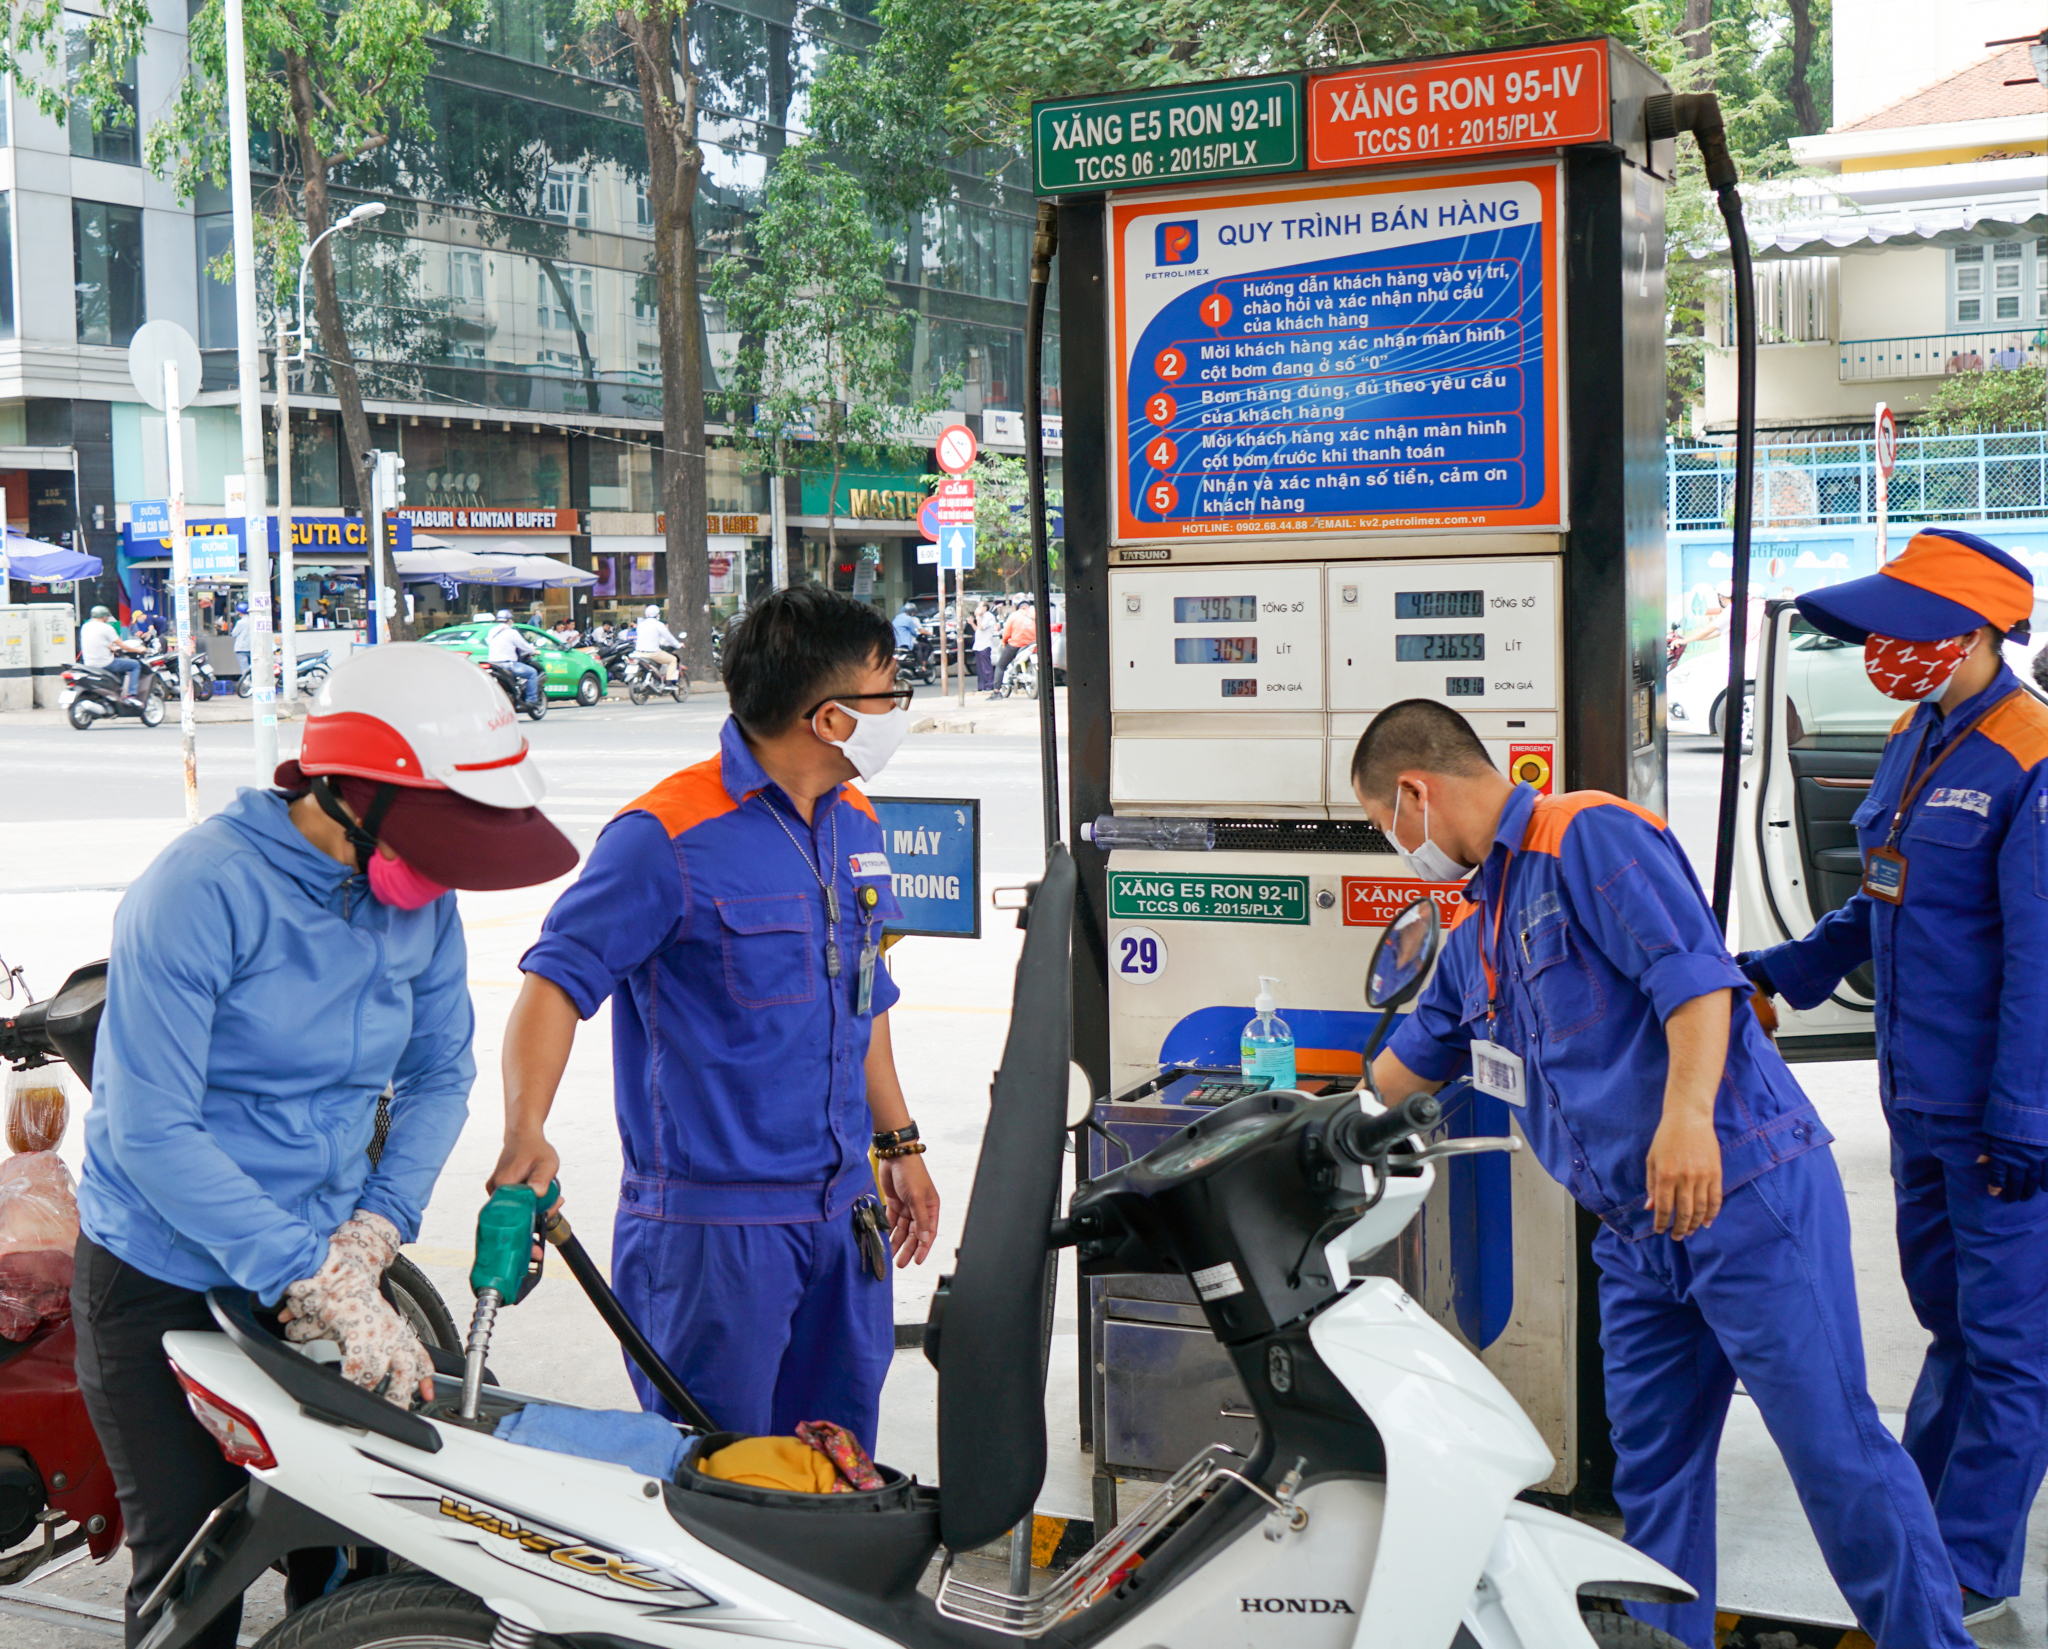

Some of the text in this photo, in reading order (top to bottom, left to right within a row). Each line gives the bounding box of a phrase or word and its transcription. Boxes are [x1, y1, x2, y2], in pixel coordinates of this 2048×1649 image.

[1330, 64, 1583, 122] XĂNG RON 95-IV
[1051, 96, 1282, 151] XĂNG E5 RON 92-II
[1354, 126, 1411, 155] TCCS
[1417, 123, 1439, 149] 01
[1460, 110, 1558, 145] 2015/PLX
[1075, 154, 1127, 181] TCCS
[1132, 152, 1153, 176] 06
[1170, 140, 1257, 172] 2015/PLX
[1218, 199, 1519, 246] QUY TRÌNH BÁN HÀNG
[1145, 268, 1210, 280] PETROLIMEX
[1243, 263, 1510, 298] Hướng dẫn khách hàng vào vị trí,
[1243, 298, 1282, 316] chào
[1286, 295, 1310, 311] hỏi
[1315, 294, 1333, 310] và
[1339, 293, 1367, 309] xác
[1371, 289, 1412, 307] nhận
[1452, 282, 1483, 300] cầu
[1208, 300, 1220, 322] 1
[1243, 313, 1369, 333] của khách hàng
[1201, 326, 1506, 360] Mời khách hàng xác nhận màn hình
[1162, 353, 1178, 376] 2
[1200, 364, 1227, 382] cột
[1231, 362, 1267, 379] bơm
[1272, 361, 1314, 377] đang
[1318, 357, 1330, 373] ở
[1335, 354, 1356, 371] số
[1201, 371, 1507, 404] Bơm hàng đúng, đủ theo yêu cầu
[1153, 398, 1168, 421] 3
[1201, 404, 1345, 425] của khách hàng
[1202, 420, 1507, 449] Mời khách hàng xác nhận màn hình
[1153, 442, 1169, 465] 4
[1202, 443, 1445, 471] cột bơm trước khi thanh toán
[945, 482, 968, 495] CẤM
[1203, 466, 1508, 495] Nhận và xác nhận số tiền, cảm ơn
[1154, 487, 1170, 509] 5
[1203, 497, 1305, 513] khách hàng
[397, 510, 557, 528] SHABURI & KINTAN BUFFET
[1182, 523, 1234, 534] HOTLINE:
[1236, 521, 1308, 532] 0902.68.44.88
[1359, 516, 1486, 529] kv2.petrolimex.com.vn
[290, 523, 341, 545] GUTA
[1121, 550, 1169, 560] TATSUNO
[1411, 592, 1483, 616] 400000
[1276, 642, 1292, 654] LÍT
[1505, 639, 1522, 651] LÍT
[893, 826, 942, 855] MÁY
[891, 873, 960, 900] TRONG
[1119, 878, 1298, 902] XĂNG E5 RON 92-II
[1354, 885, 1422, 903] XĂNG
[1136, 900, 1179, 913] TCCS
[1182, 901, 1201, 914] 06
[1213, 902, 1284, 917] 2015/PLX
[1120, 937, 1158, 974] 29
[1240, 1598, 1356, 1614] HONDA
